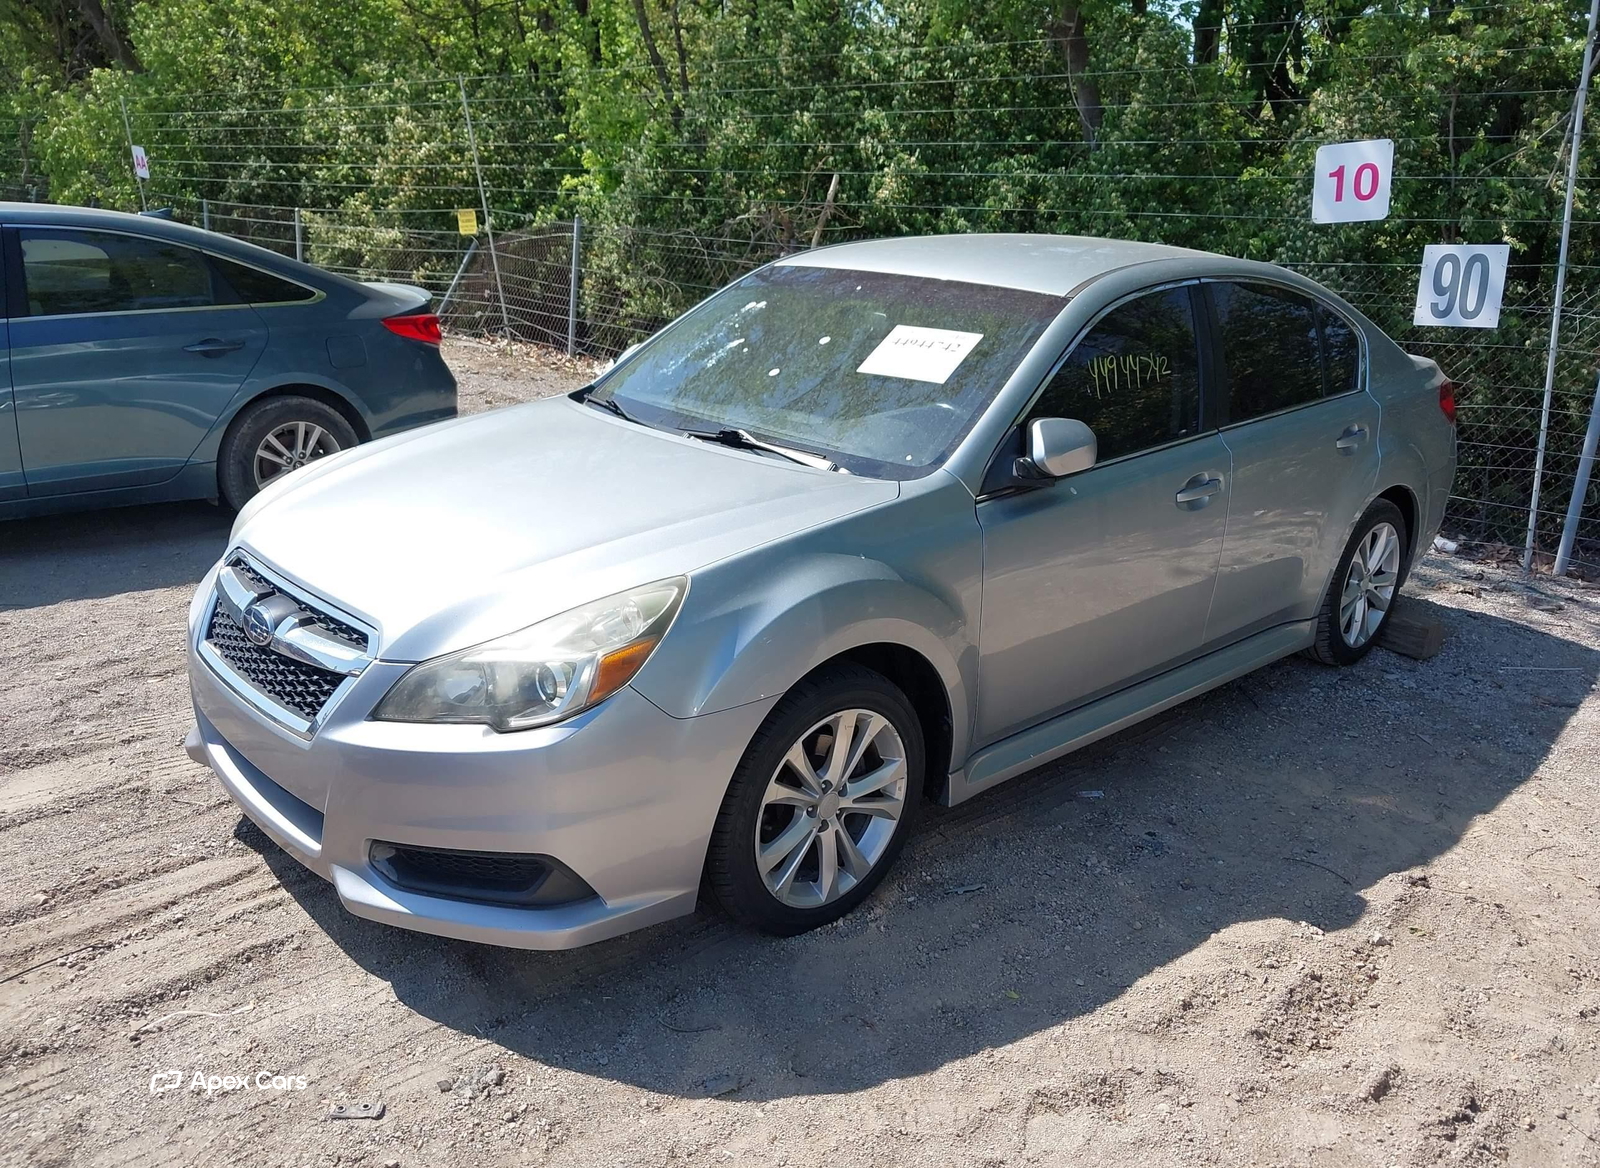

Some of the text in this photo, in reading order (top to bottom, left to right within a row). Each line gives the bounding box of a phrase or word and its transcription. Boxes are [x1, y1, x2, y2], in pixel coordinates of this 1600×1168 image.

[135, 154, 146, 169] AA
[1328, 162, 1380, 202] 10
[1430, 253, 1490, 320] 90
[1087, 353, 1172, 399] 44944742
